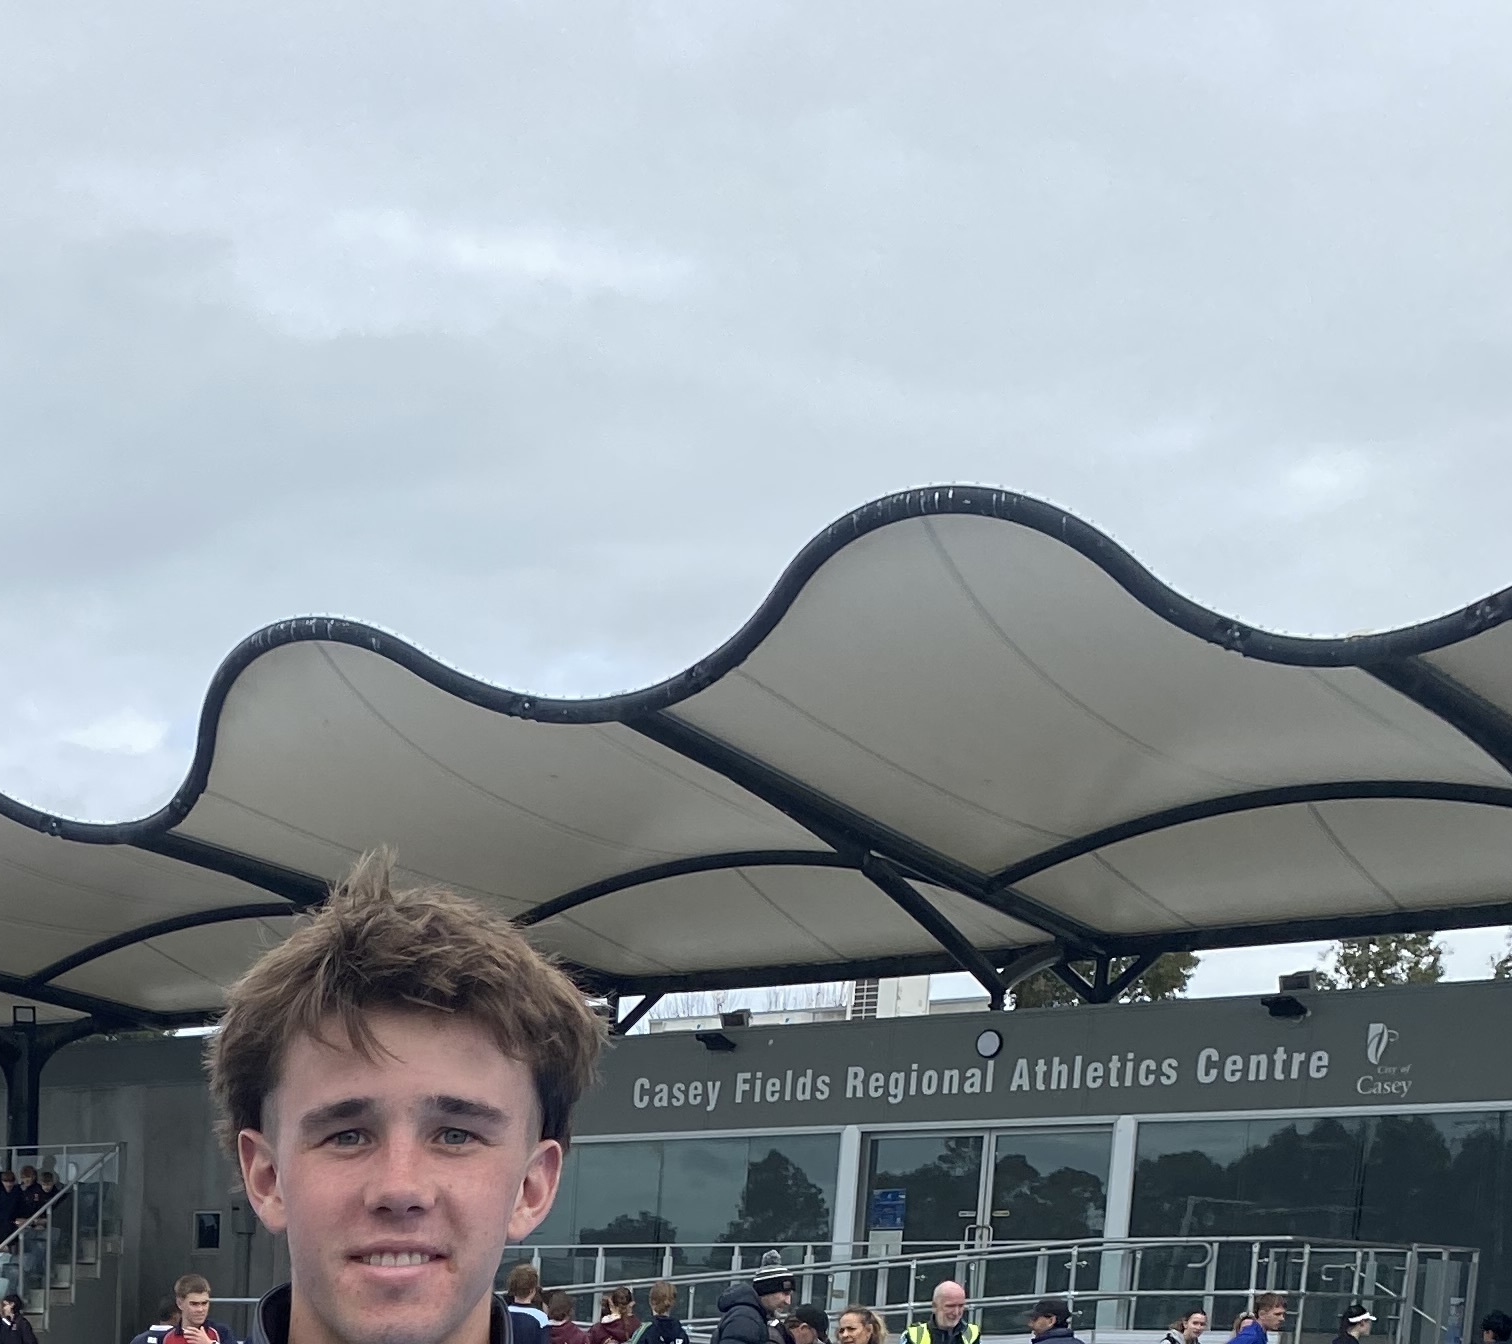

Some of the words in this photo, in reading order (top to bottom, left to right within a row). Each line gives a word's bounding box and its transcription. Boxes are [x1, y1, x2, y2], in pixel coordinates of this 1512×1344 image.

[632, 1076, 722, 1112] Casey
[735, 1068, 831, 1104] Fields
[845, 1059, 995, 1104] Regional
[1009, 1051, 1179, 1092] Athletics
[1196, 1045, 1330, 1084] Centre
[1357, 1075, 1413, 1098] Casey
